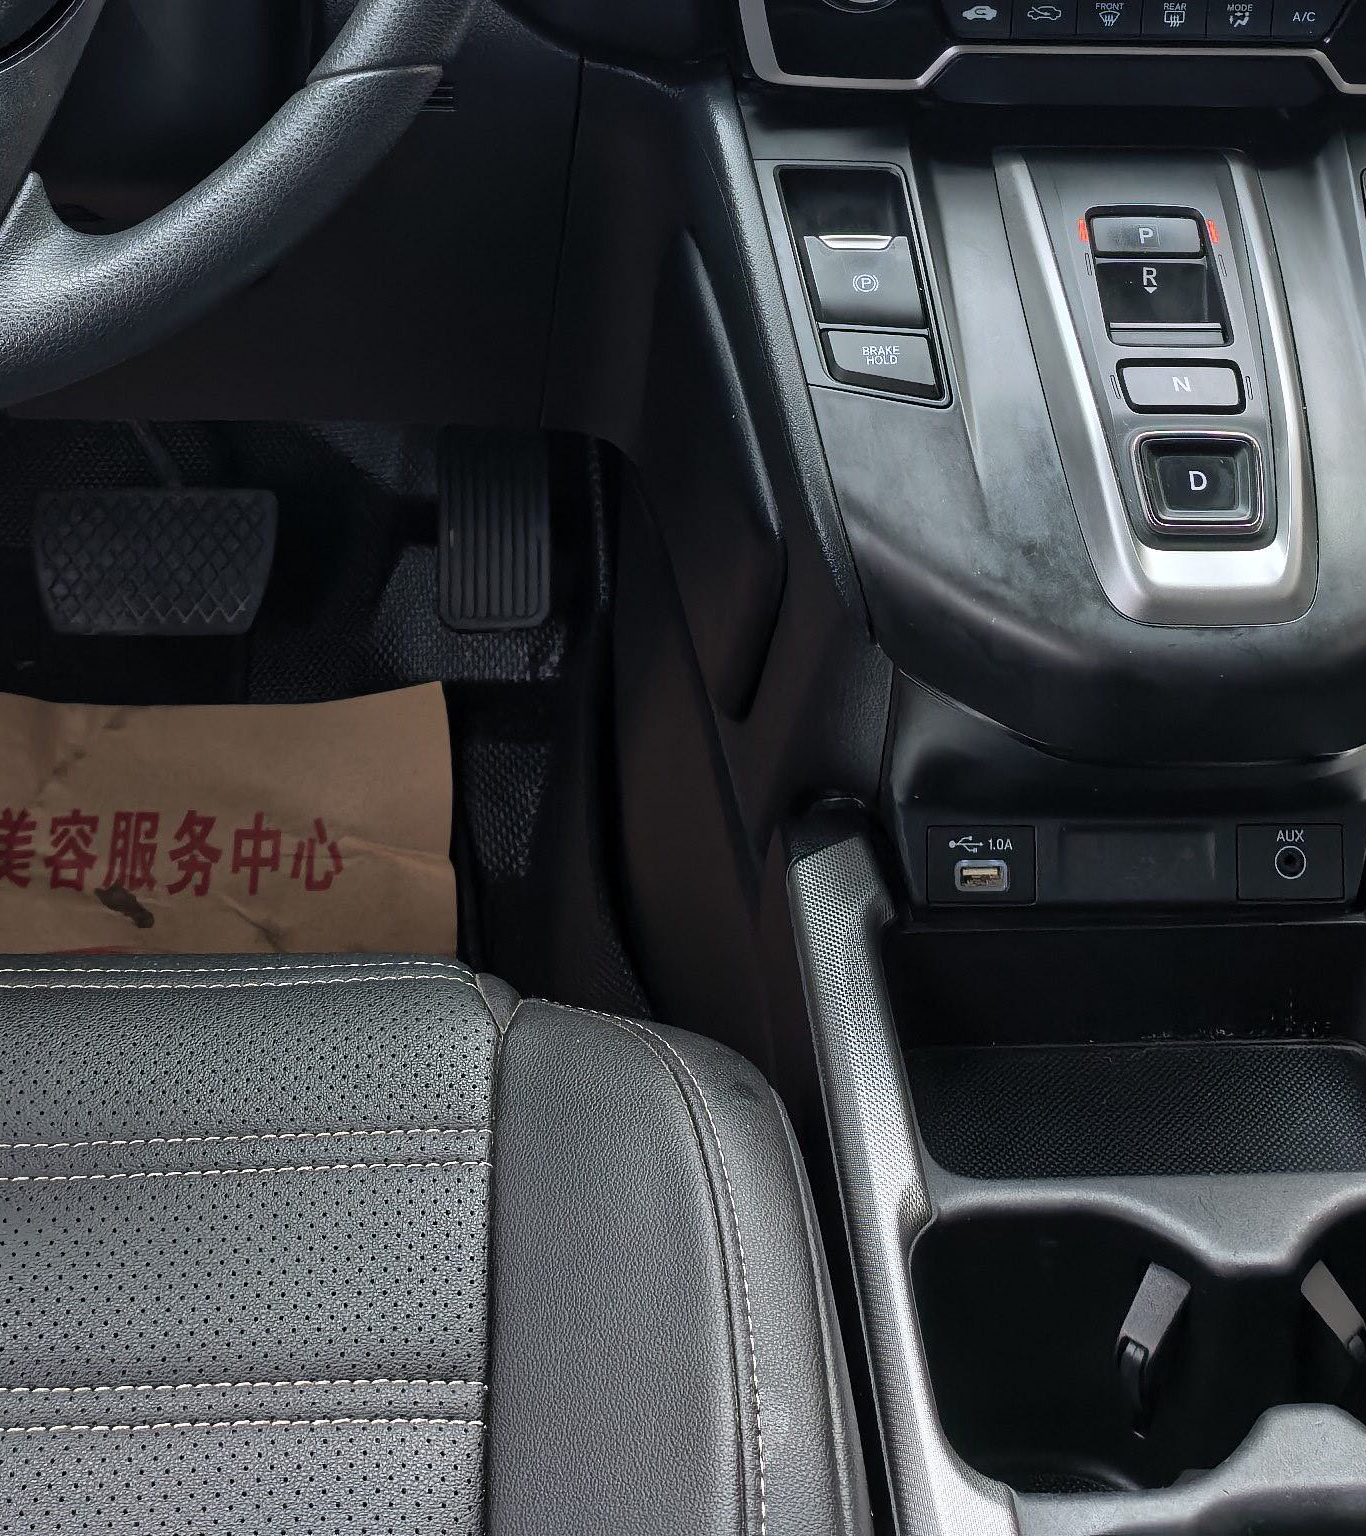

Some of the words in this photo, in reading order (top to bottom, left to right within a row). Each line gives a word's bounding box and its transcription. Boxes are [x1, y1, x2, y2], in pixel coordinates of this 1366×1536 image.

[1095, 3, 1124, 11] FRONT
[1163, 3, 1187, 11] REAR
[1227, 4, 1253, 12] MODE
[1292, 11, 1316, 23] A/C
[1138, 227, 1154, 244] P
[1143, 267, 1157, 286] R
[862, 345, 900, 356] BRAKE
[866, 354, 898, 365] HOLD
[1172, 376, 1191, 393] N
[1189, 470, 1207, 491] D
[1276, 829, 1305, 843] AUX
[988, 838, 1013, 851] 1.0A
